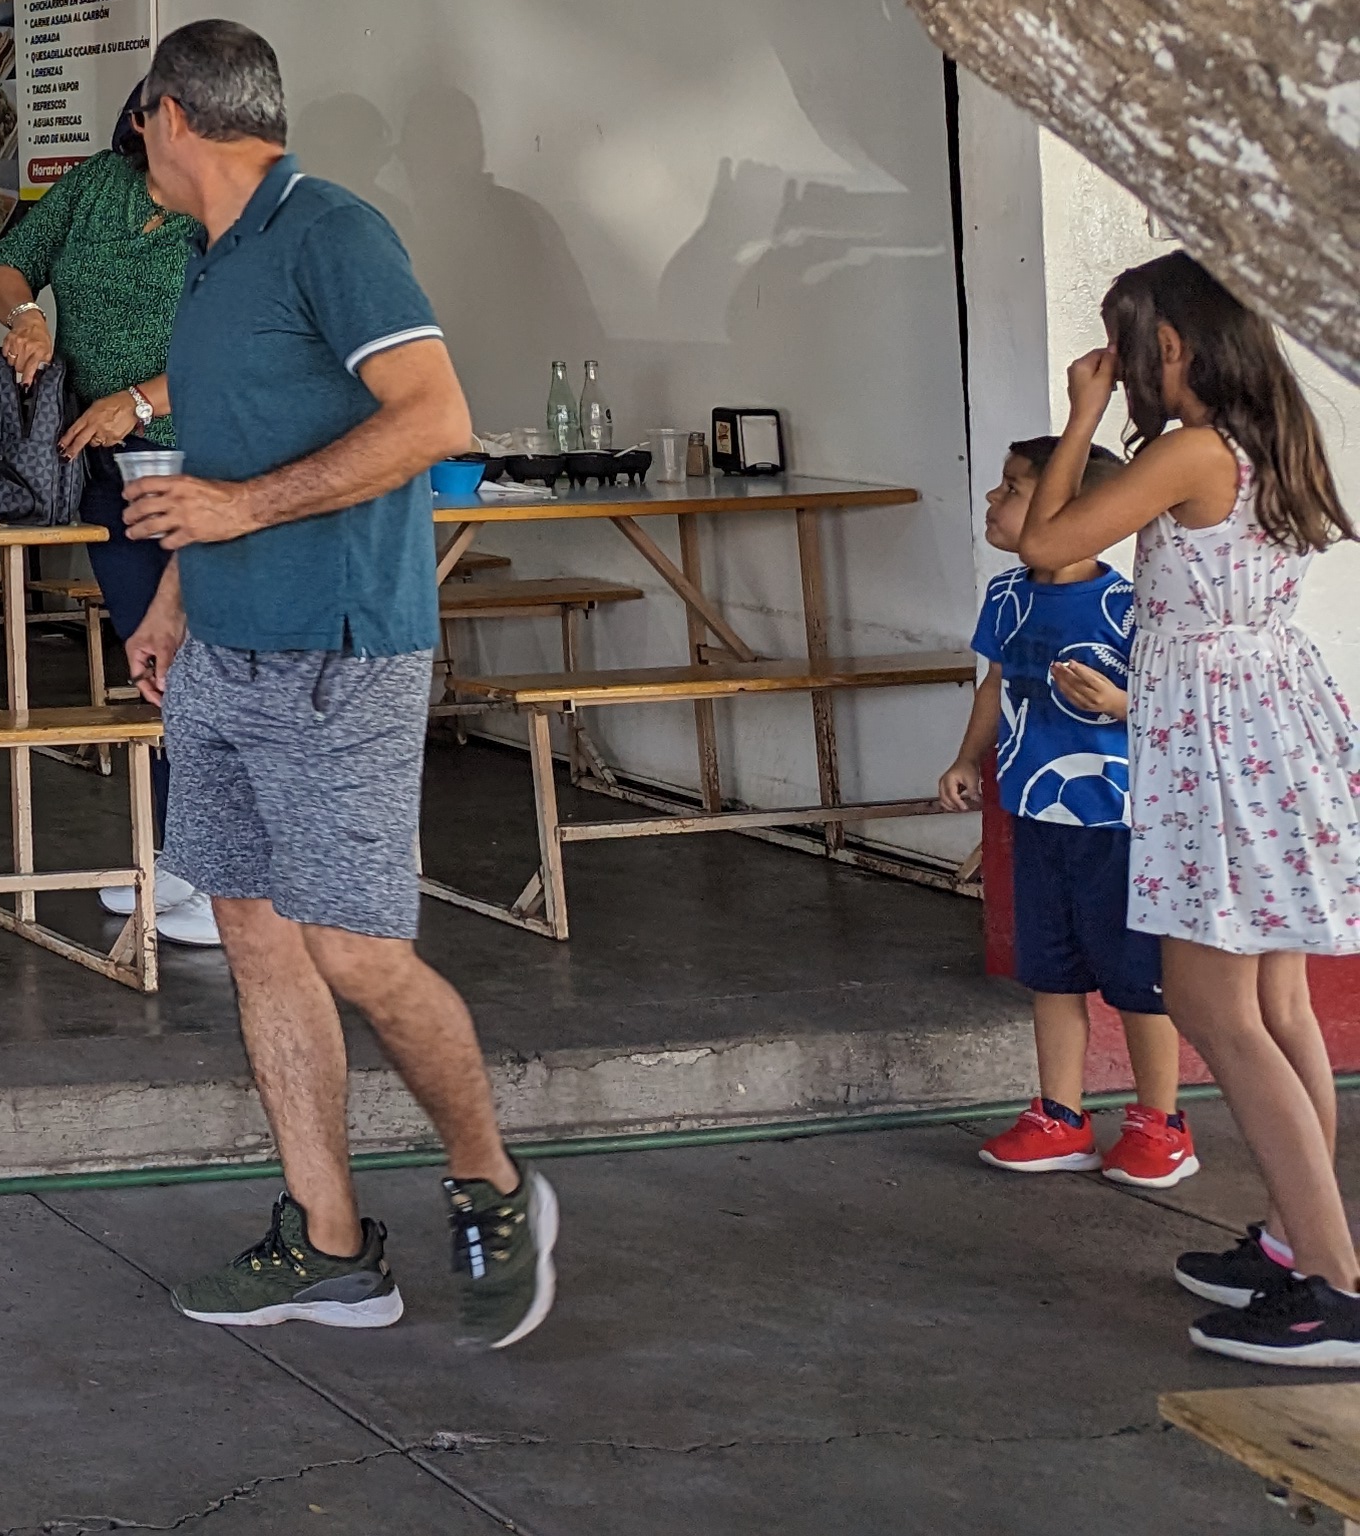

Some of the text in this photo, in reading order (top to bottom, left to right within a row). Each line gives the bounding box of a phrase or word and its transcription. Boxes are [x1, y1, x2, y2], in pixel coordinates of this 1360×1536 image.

[30, 16, 50, 28] CARNE
[51, 13, 72, 25] ASADA
[73, 11, 81, 22] AL
[30, 33, 60, 45] ADOBADA
[31, 47, 72, 63] QUESADILLAS
[102, 43, 107, 53] A
[107, 42, 117, 53] SU
[32, 81, 79, 95] TACOS A VAPOR
[32, 99, 67, 111] REFRESCOS
[33, 115, 82, 128] AGUAS FRESCAS
[33, 132, 90, 145] JUGO DE NARANJA
[32, 163, 62, 176] Horario
